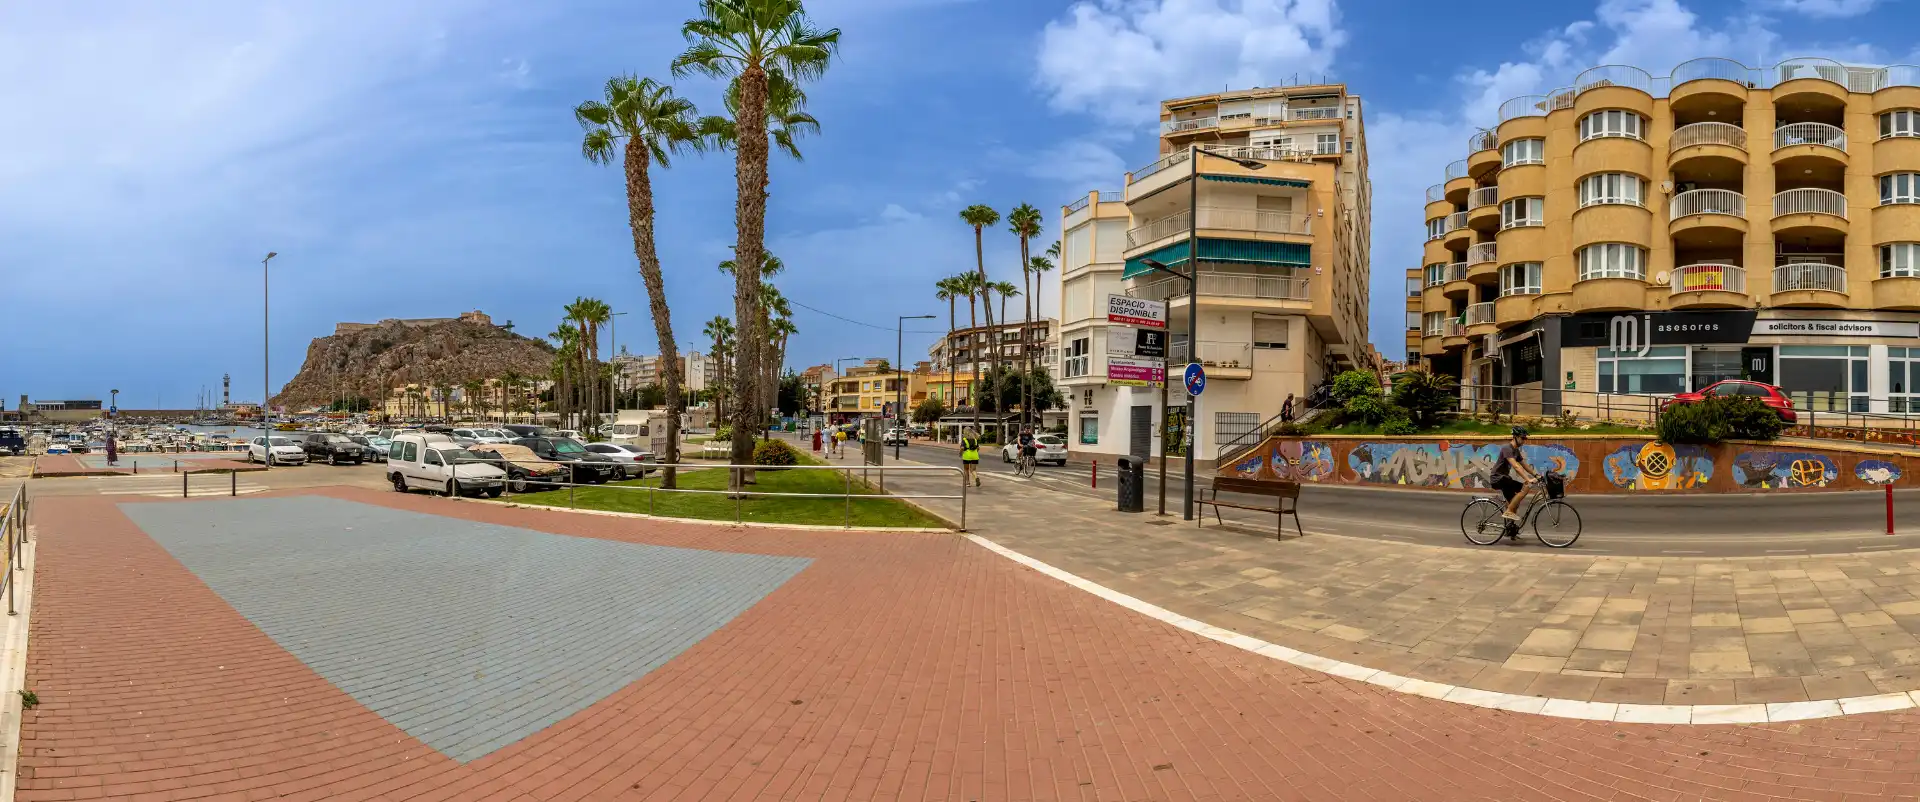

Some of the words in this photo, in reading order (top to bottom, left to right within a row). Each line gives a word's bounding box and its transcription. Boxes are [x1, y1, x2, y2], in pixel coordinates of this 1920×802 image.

[1110, 297, 1145, 309] ESPACIO
[1109, 305, 1158, 319] DISPONIBLE
[1768, 323, 1806, 331] solicitors
[1808, 323, 1814, 331] &
[1815, 323, 1837, 331] fiscal
[1838, 324, 1873, 332] advisors
[1610, 315, 1651, 357] mj
[1658, 323, 1719, 332] asesores
